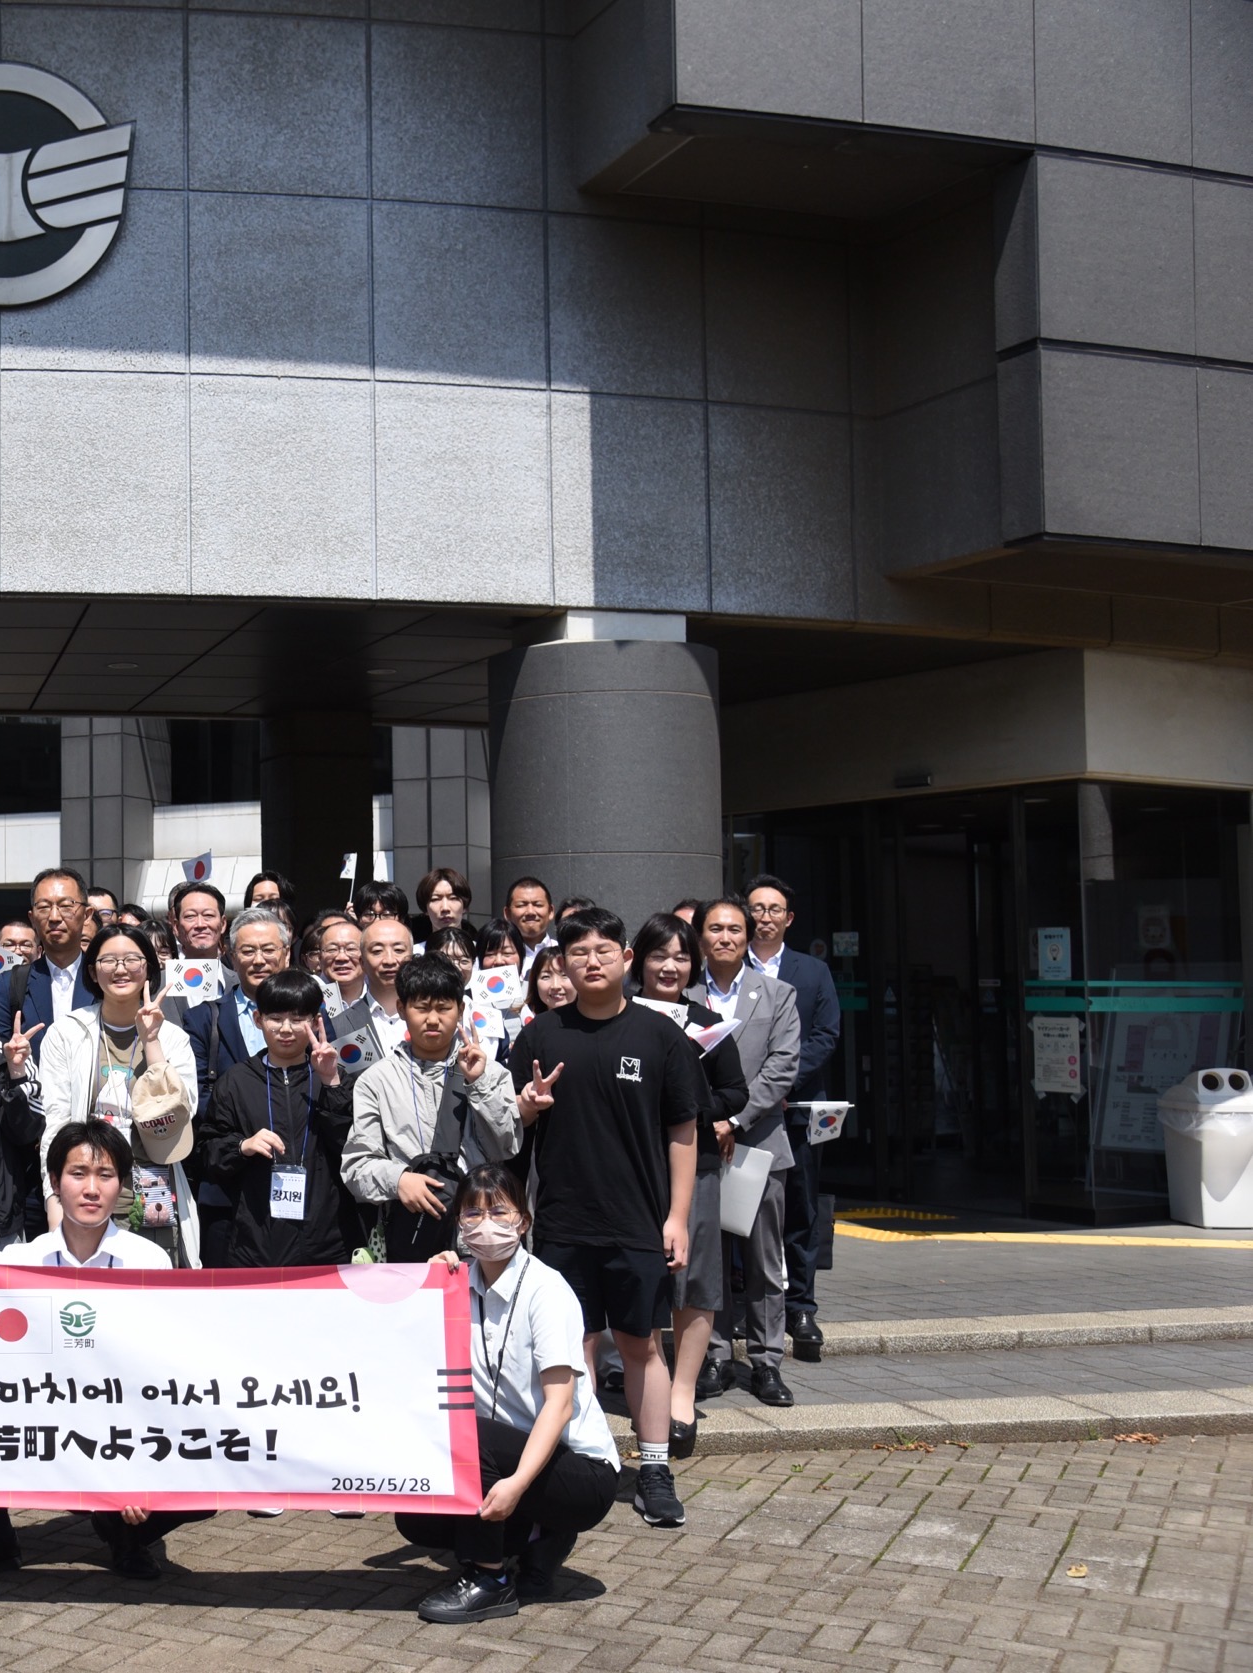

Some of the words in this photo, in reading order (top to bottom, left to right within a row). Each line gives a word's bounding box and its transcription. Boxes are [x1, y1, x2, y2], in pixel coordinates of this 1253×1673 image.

[140, 1115, 176, 1129] ICONIC
[272, 1189, 302, 1203] 강지원
[63, 1338, 95, 1349] 三芳町
[141, 1378, 220, 1406] 어서
[236, 1372, 360, 1413] 오세요!
[331, 1477, 432, 1493] 2025/5/28
